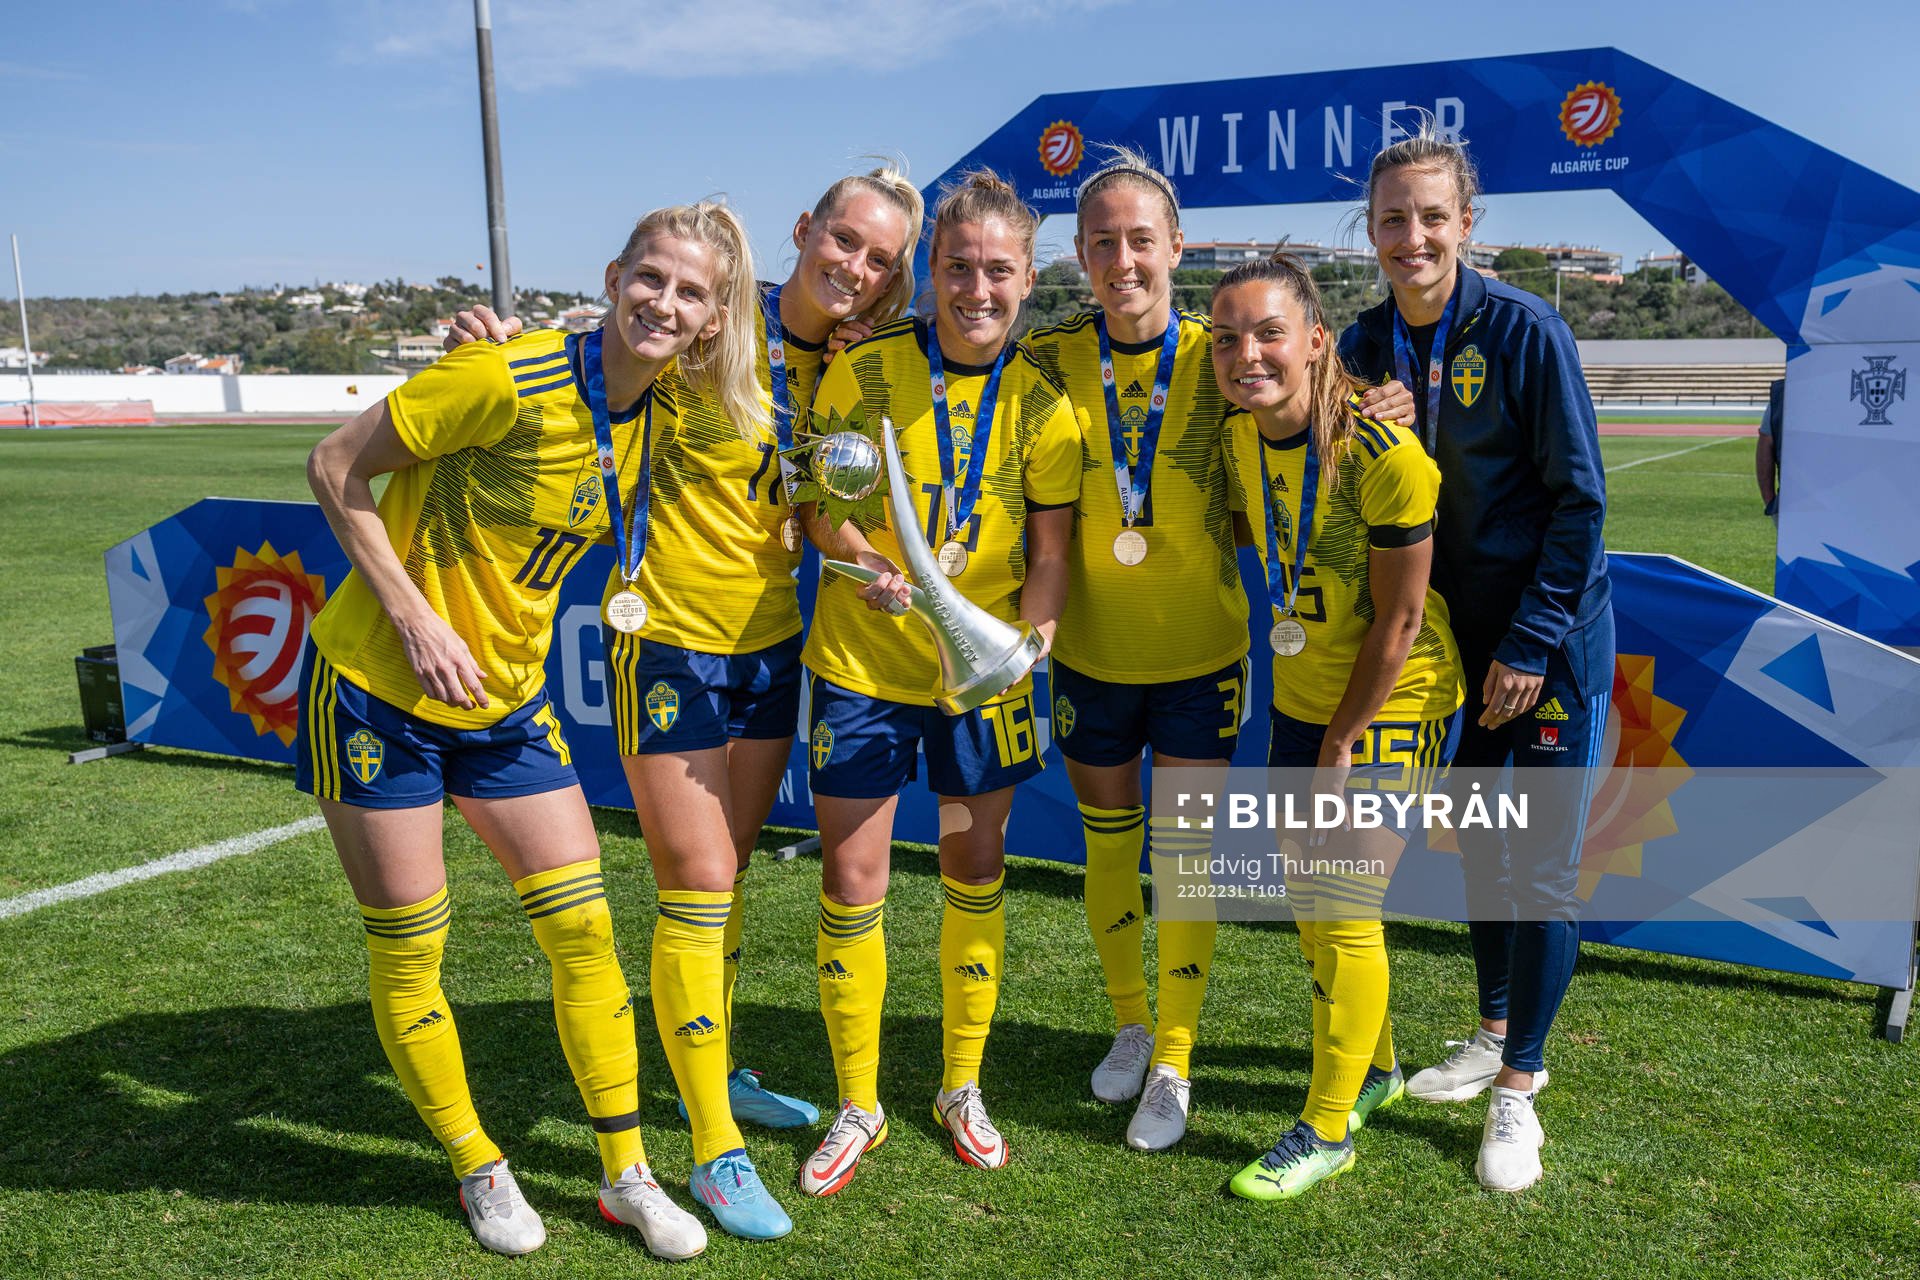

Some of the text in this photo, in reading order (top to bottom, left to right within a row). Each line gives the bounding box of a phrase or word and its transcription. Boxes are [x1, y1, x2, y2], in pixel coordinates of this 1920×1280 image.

[1158, 97, 1466, 176] WINNER
[1550, 157, 1630, 175] ALGARVE CUP
[1032, 187, 1071, 199] ALGARVE
[1121, 389, 1148, 398] adidas
[511, 527, 589, 592] 10
[920, 572, 980, 663] ALGARVE CUP 2022
[1217, 677, 1241, 739] 3
[1535, 711, 1569, 720] adidas
[980, 696, 1033, 768] 16
[1105, 916, 1140, 934] adidas
[818, 969, 854, 980] adidas
[954, 967, 996, 982] adidas
[1168, 970, 1204, 980] adidas
[401, 1015, 446, 1036] adidas
[674, 1023, 720, 1037] adidas
